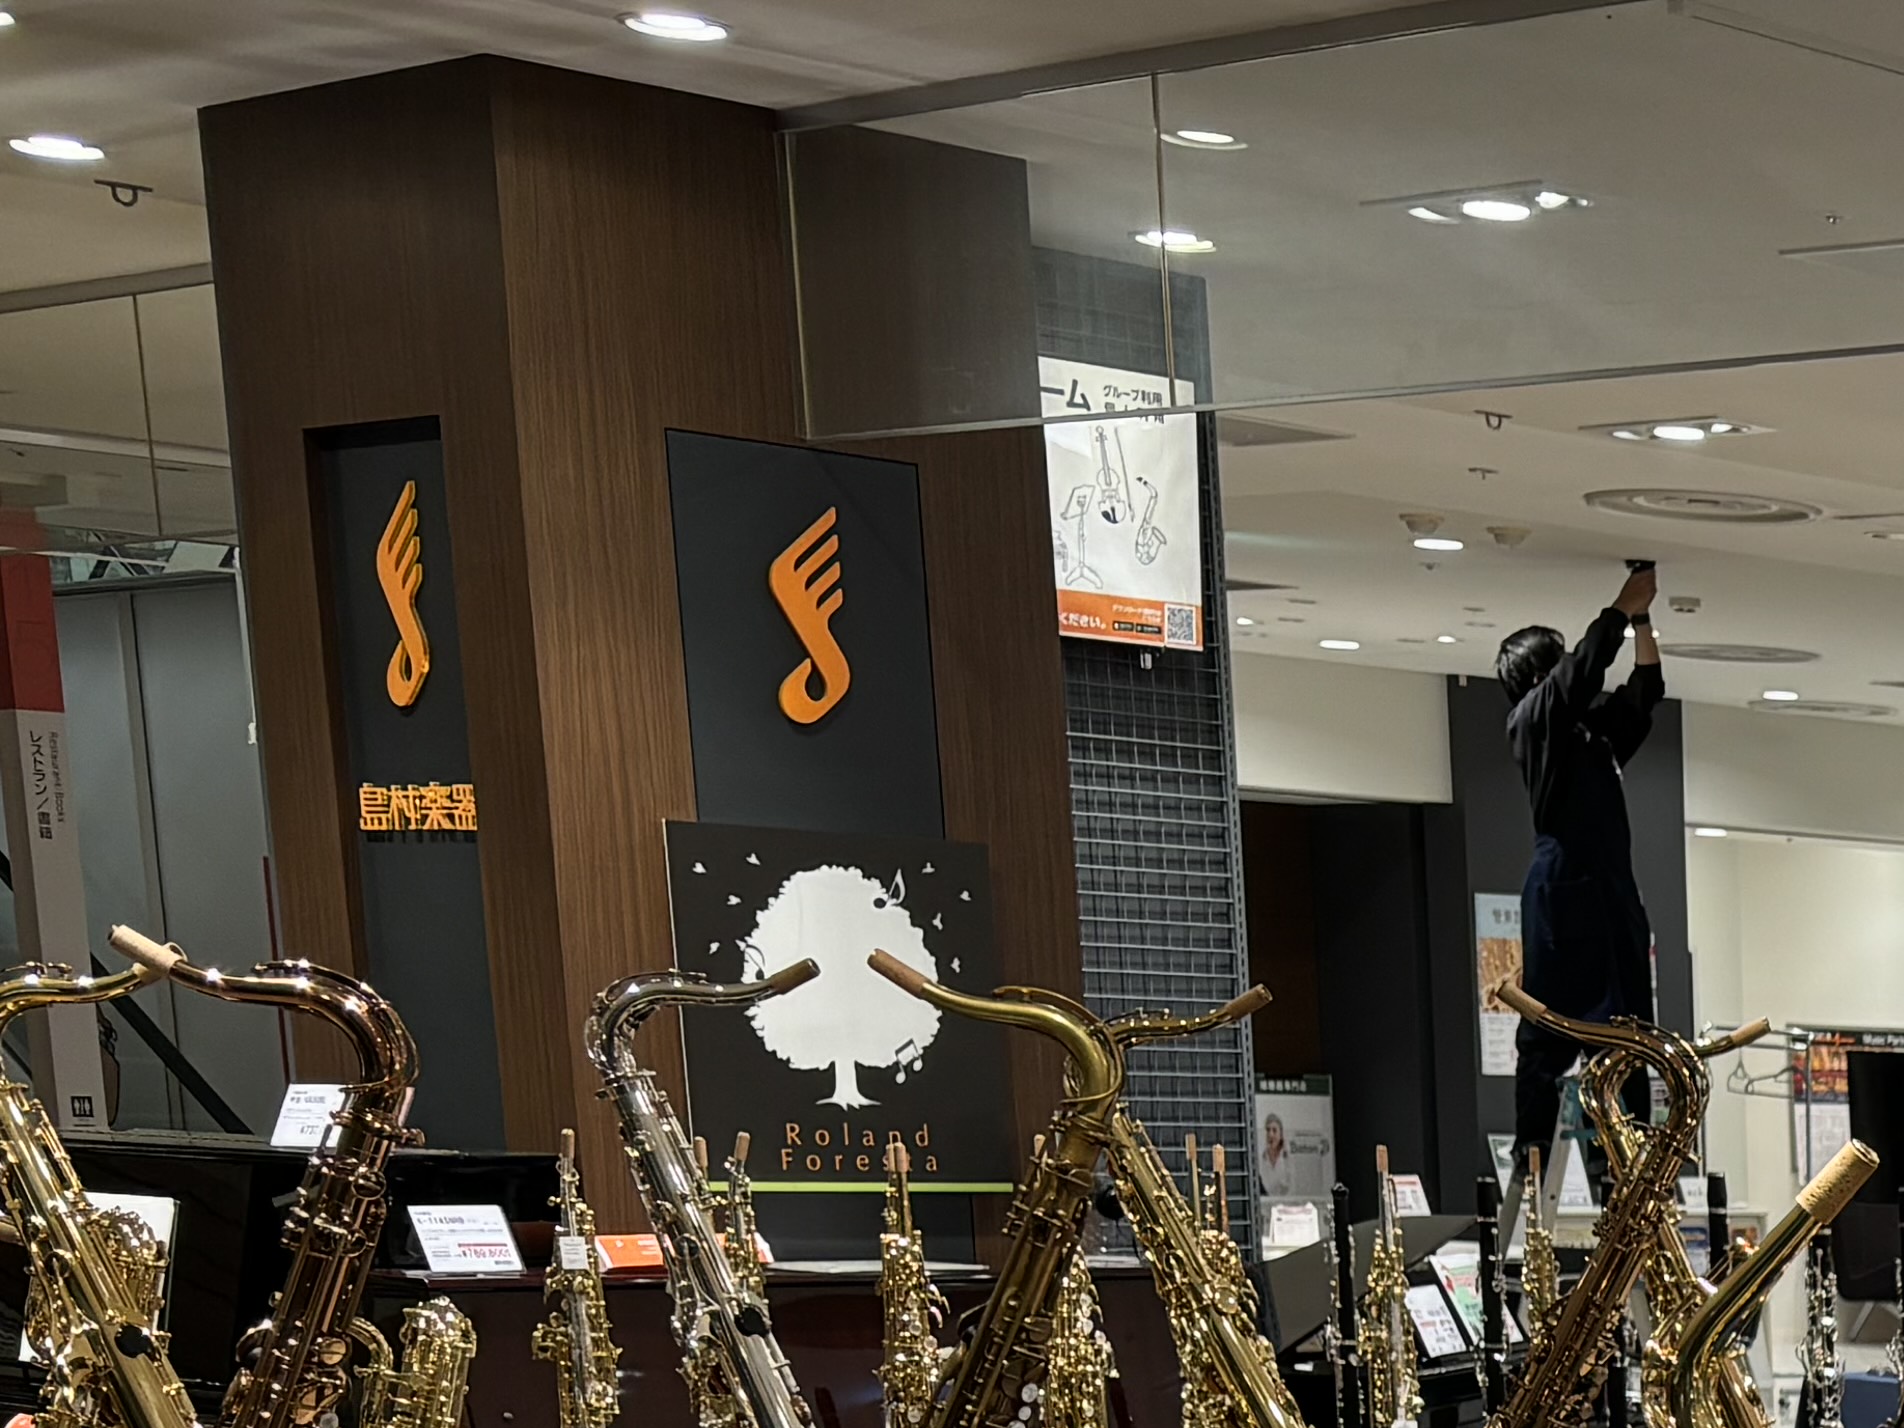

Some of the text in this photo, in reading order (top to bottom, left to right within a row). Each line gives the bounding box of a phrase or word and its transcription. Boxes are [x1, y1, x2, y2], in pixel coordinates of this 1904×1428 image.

[1103, 384, 1163, 407] グループ利用
[359, 781, 478, 831] 島村楽器
[785, 1122, 929, 1147] Roland
